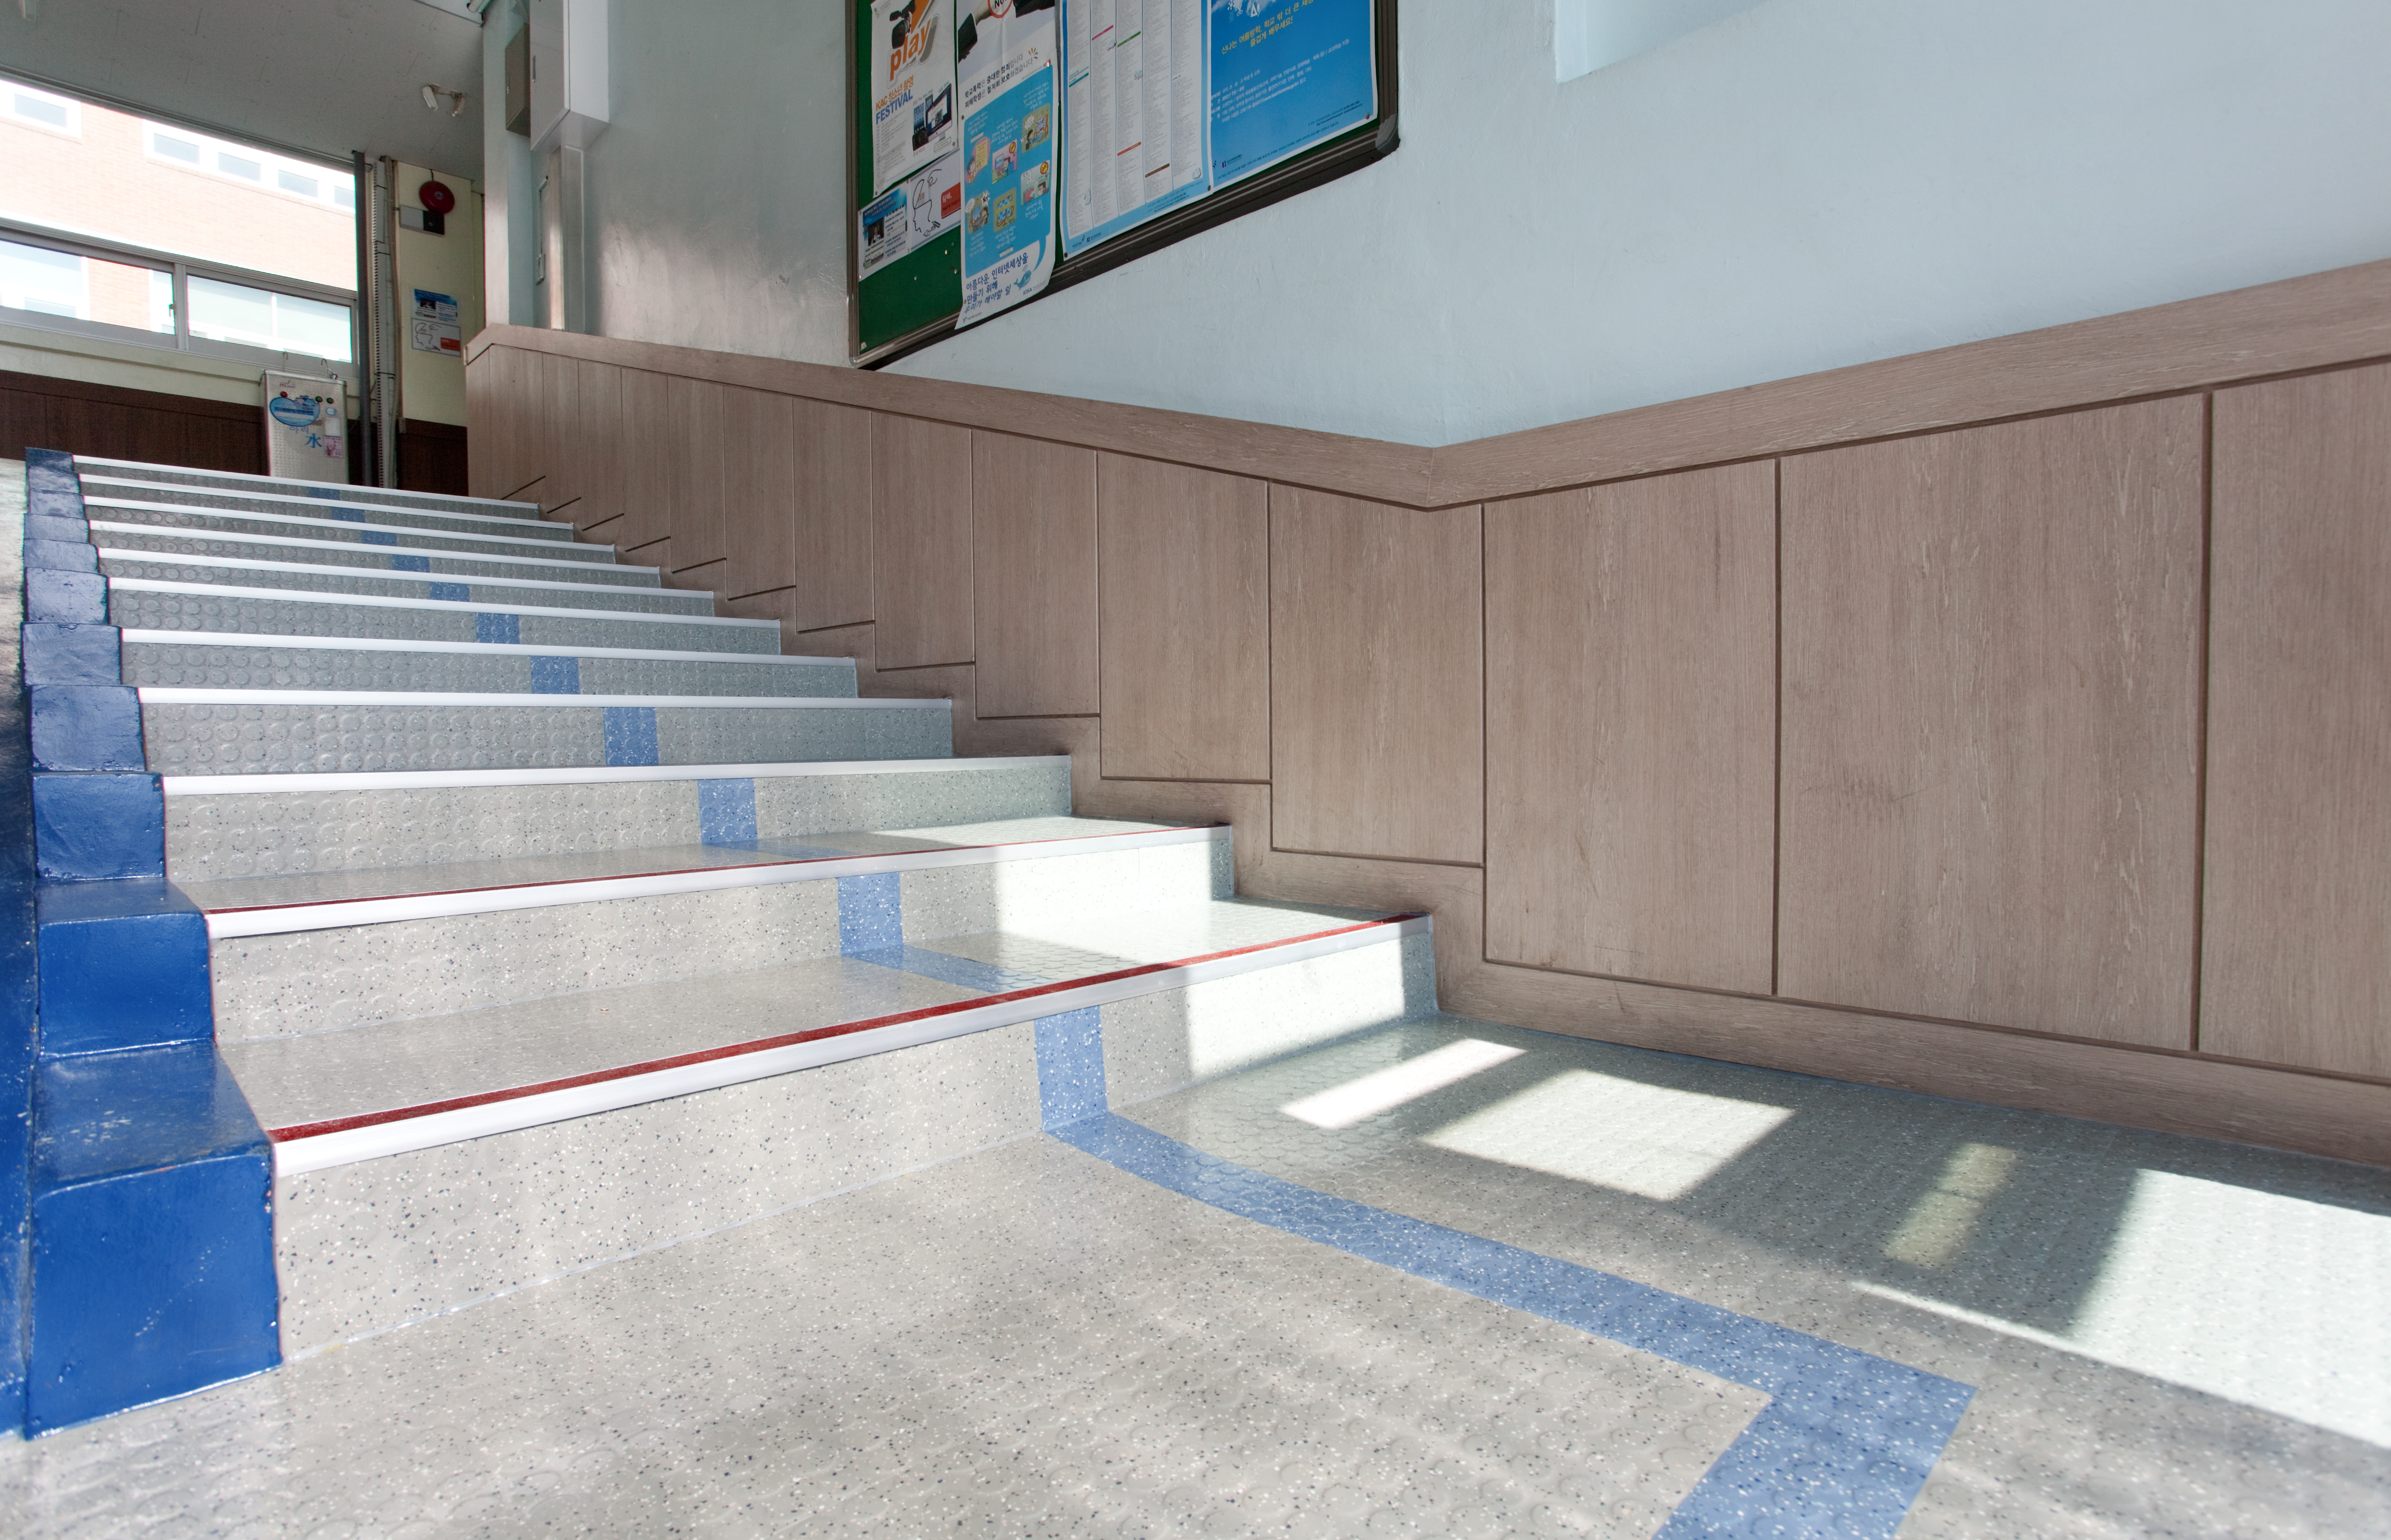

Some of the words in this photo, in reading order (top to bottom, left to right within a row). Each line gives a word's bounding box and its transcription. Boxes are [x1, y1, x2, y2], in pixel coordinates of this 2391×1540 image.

[1222, 41, 1237, 54] 신나는
[1264, 17, 1275, 28] 학교
[1277, 11, 1283, 21] 밖
[1285, 7, 1291, 15] 더
[1251, 31, 1266, 47] 즐겁게
[1269, 15, 1293, 35] 배우세요!
[890, 19, 931, 82] play
[876, 95, 888, 112] KAC
[888, 83, 903, 103] 청소년
[904, 75, 914, 92] 촬영
[965, 80, 986, 98] 학교폭력은
[987, 69, 1000, 84] 중대한
[1001, 53, 1023, 74] 범죄입니다
[965, 89, 986, 108] 피해학생은
[987, 79, 1000, 94] 철저히
[1001, 57, 1034, 84] 보호하겠습니다
[876, 89, 913, 125] FESTIVAL
[943, 192, 952, 203] 담배,
[966, 273, 989, 291] 아름다운
[992, 252, 1028, 280] 인터넷세상을
[964, 299, 983, 314] 우리가
[985, 289, 1003, 304] 해야할
[1005, 284, 1011, 296] 일
[967, 288, 983, 305] 만들기
[986, 280, 997, 294] 위해
[304, 433, 323, 448] 水
